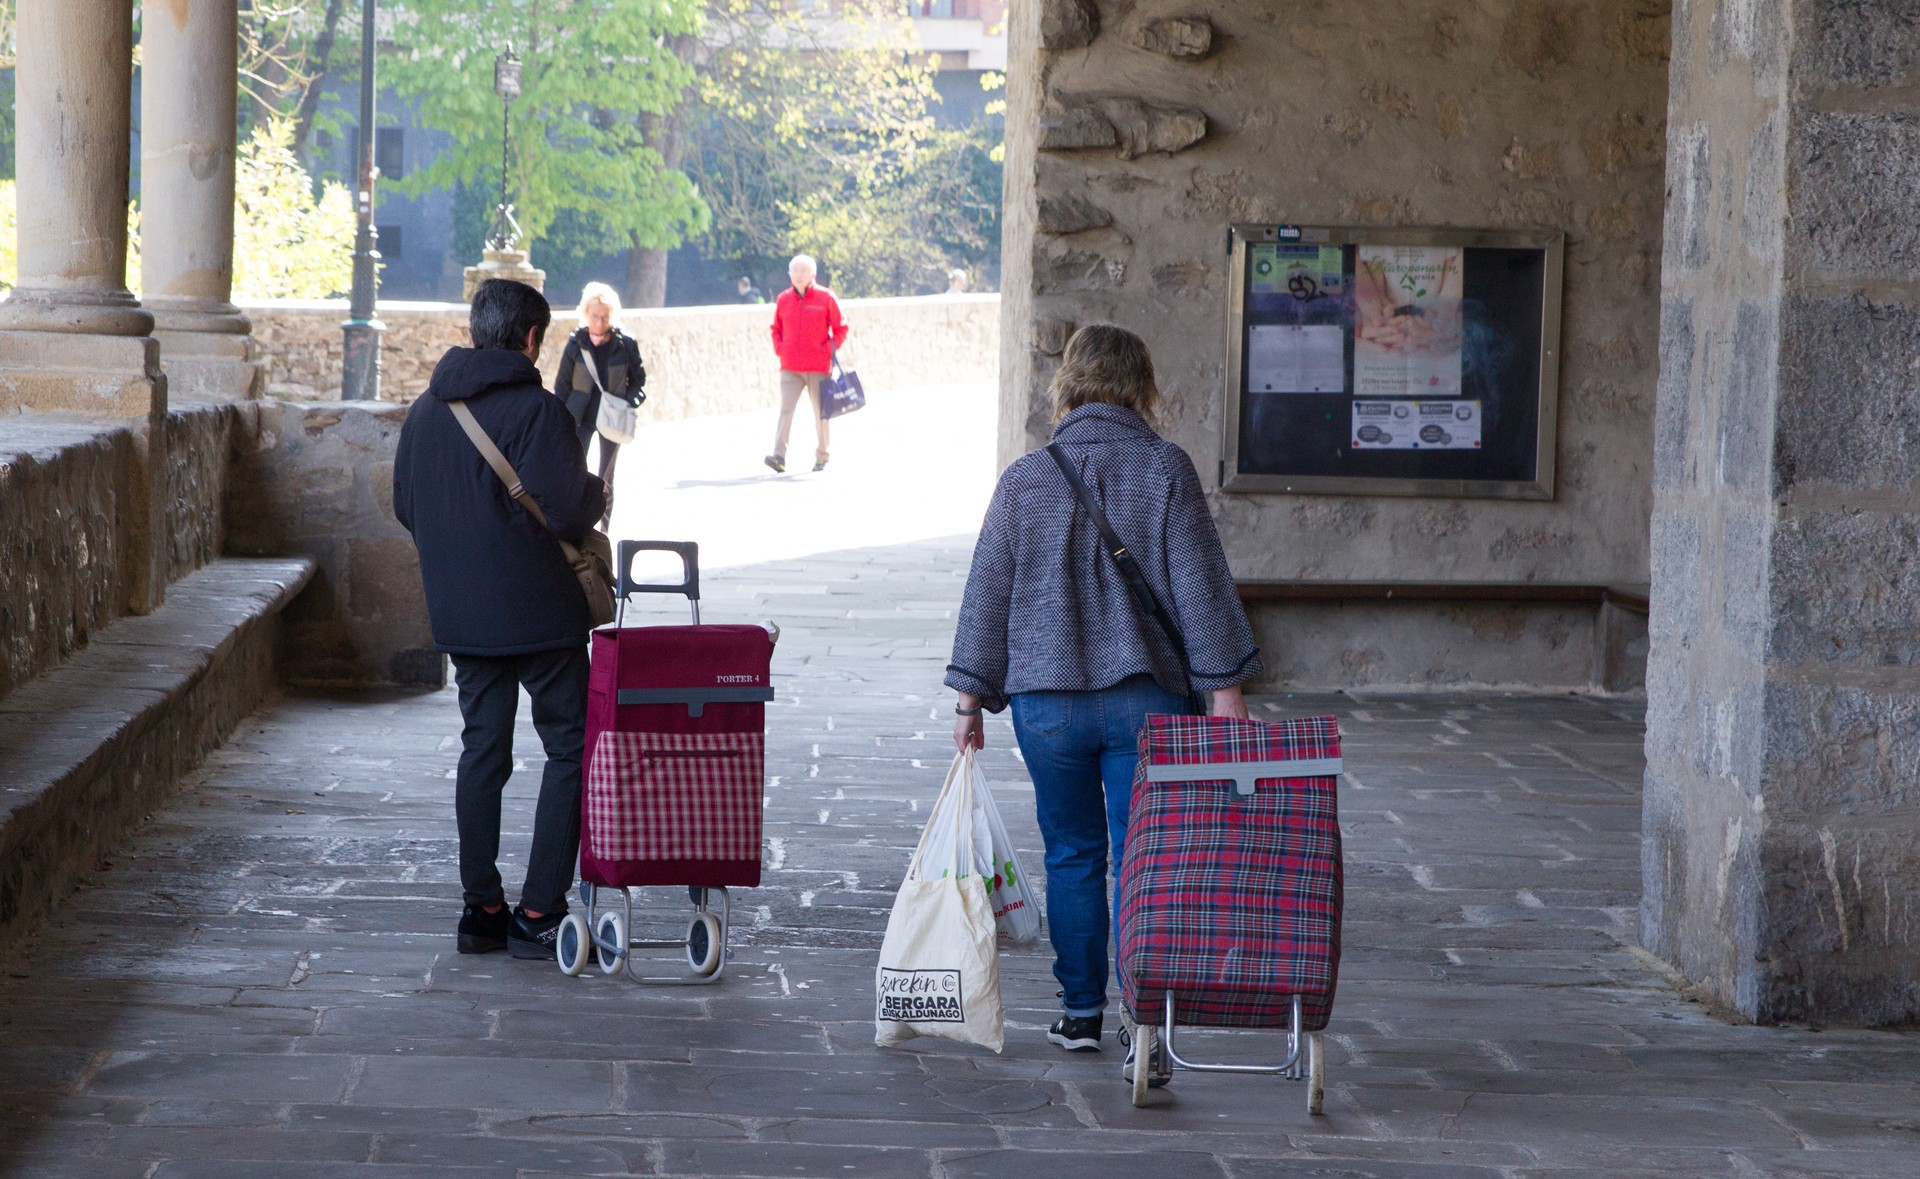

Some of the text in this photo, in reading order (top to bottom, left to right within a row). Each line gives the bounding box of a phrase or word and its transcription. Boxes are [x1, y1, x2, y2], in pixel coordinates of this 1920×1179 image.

[716, 675, 753, 683] PORTER
[885, 996, 960, 1009] BERGARA
[882, 1008, 960, 1018] EUSKALDUNAGO
